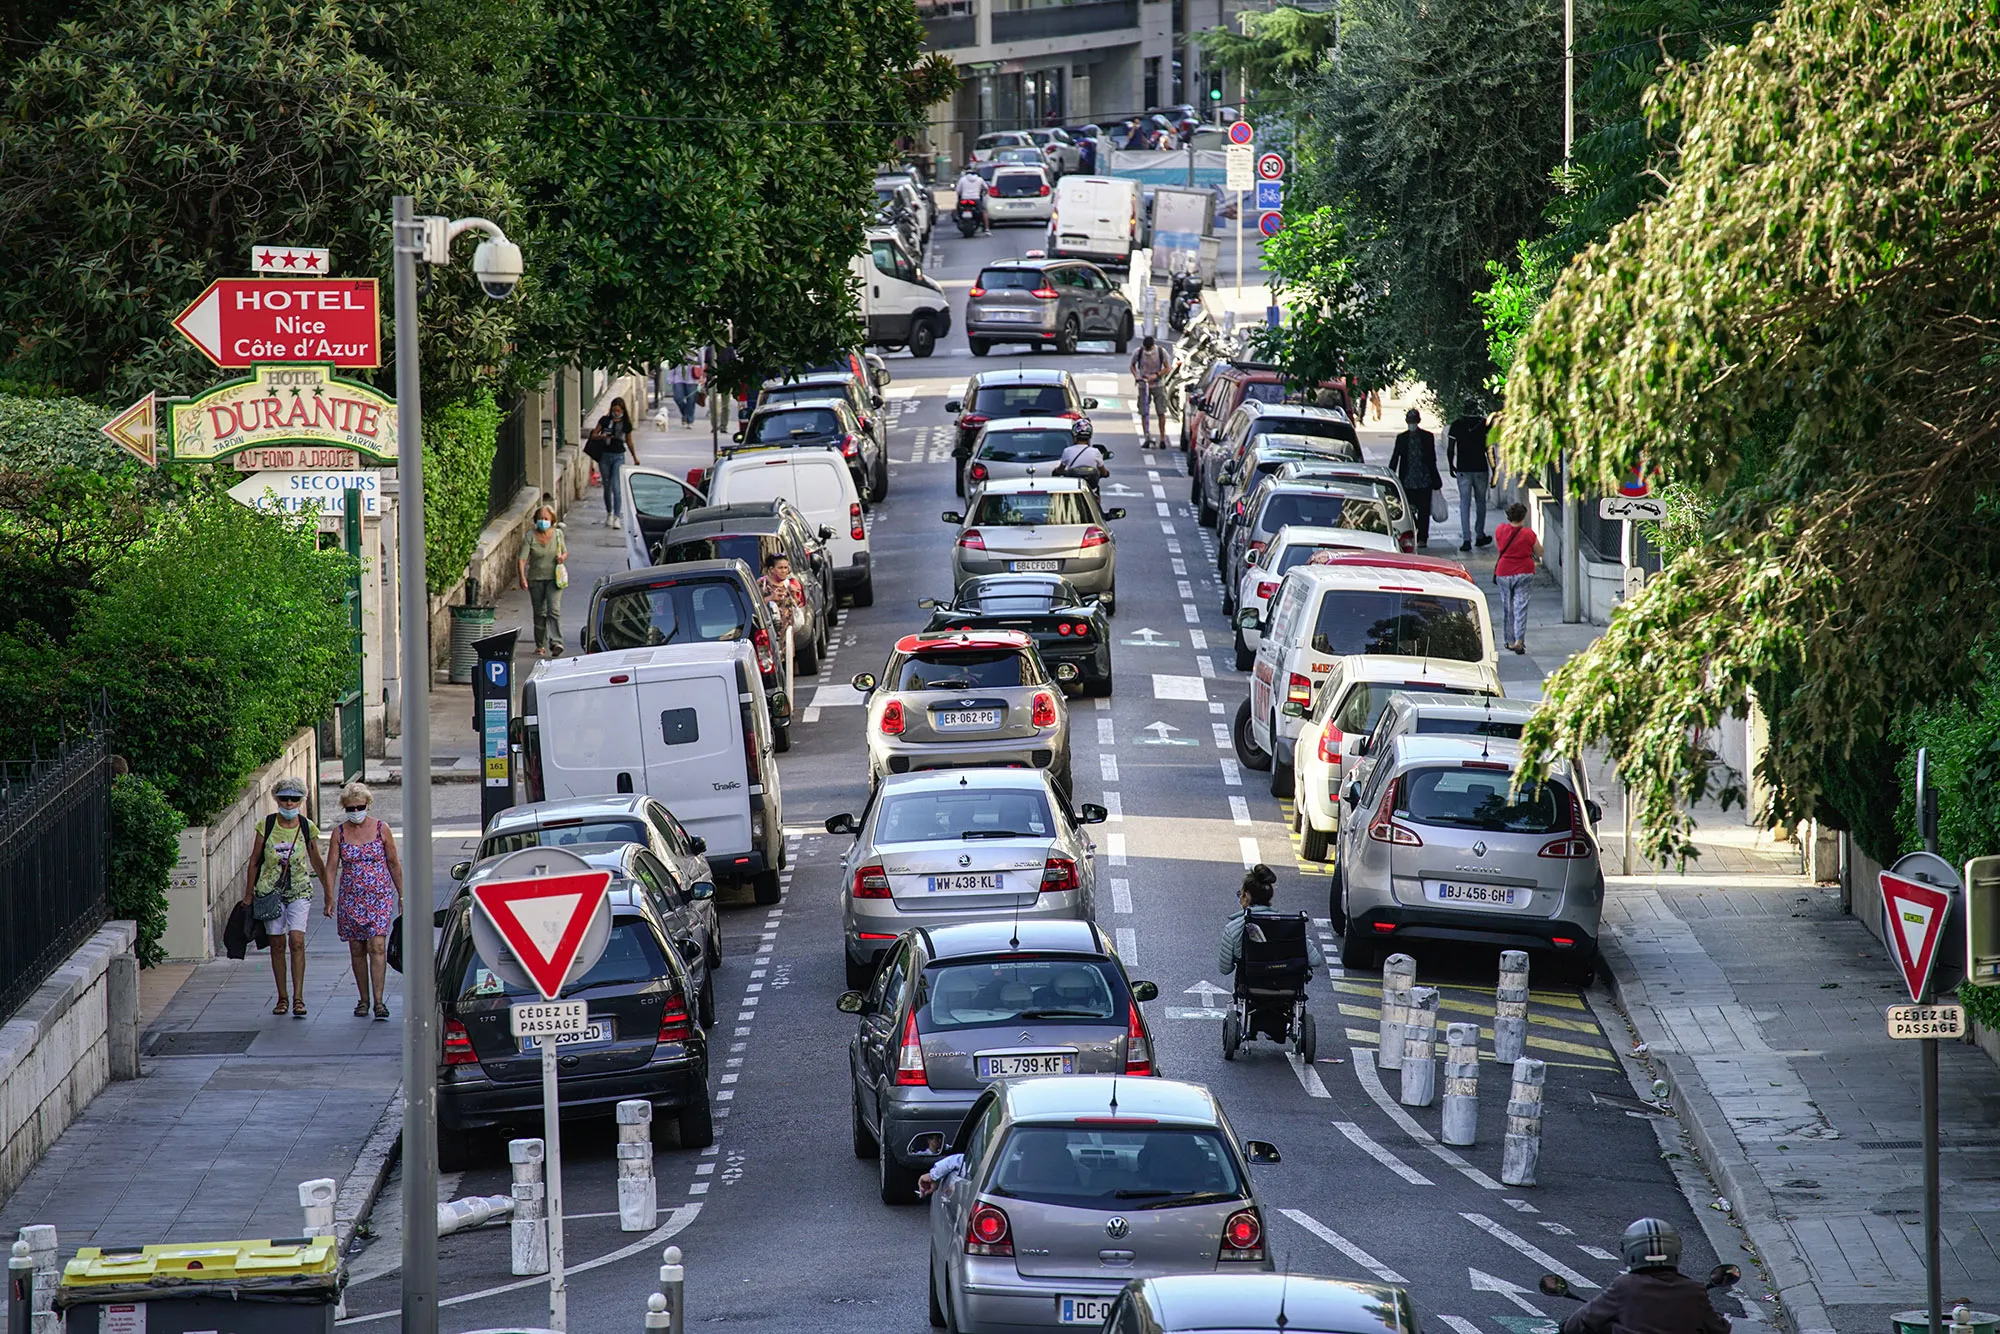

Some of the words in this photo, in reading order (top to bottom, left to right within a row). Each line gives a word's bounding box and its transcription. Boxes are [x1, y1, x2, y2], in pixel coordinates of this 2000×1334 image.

[1264, 162, 1279, 172] 30
[236, 291, 365, 310] HOTEL
[276, 316, 326, 334] Nice
[234, 338, 286, 357] Côte
[294, 338, 368, 357] d'Azur
[267, 371, 324, 386] HOTEL
[207, 395, 382, 439] DURANTE
[212, 436, 245, 454] JARDIN
[346, 435, 383, 453] PARKING
[239, 451, 257, 467] AU
[291, 475, 375, 490] SECOURS
[491, 663, 505, 682] P
[944, 712, 993, 724] ER-062-PG
[712, 781, 741, 791] Trafic
[937, 876, 995, 890] WW-438-KL
[1447, 885, 1506, 902] BJ-456-GH
[519, 1006, 561, 1019] CÉDEZ
[566, 1005, 580, 1016] LE
[1895, 1009, 1937, 1021] CÉDEZ
[1943, 1010, 1958, 1021] LE
[521, 1018, 580, 1032] PASSAGE
[1897, 1023, 1957, 1034] PASSAGE
[991, 1057, 1060, 1074] BL-799-KF
